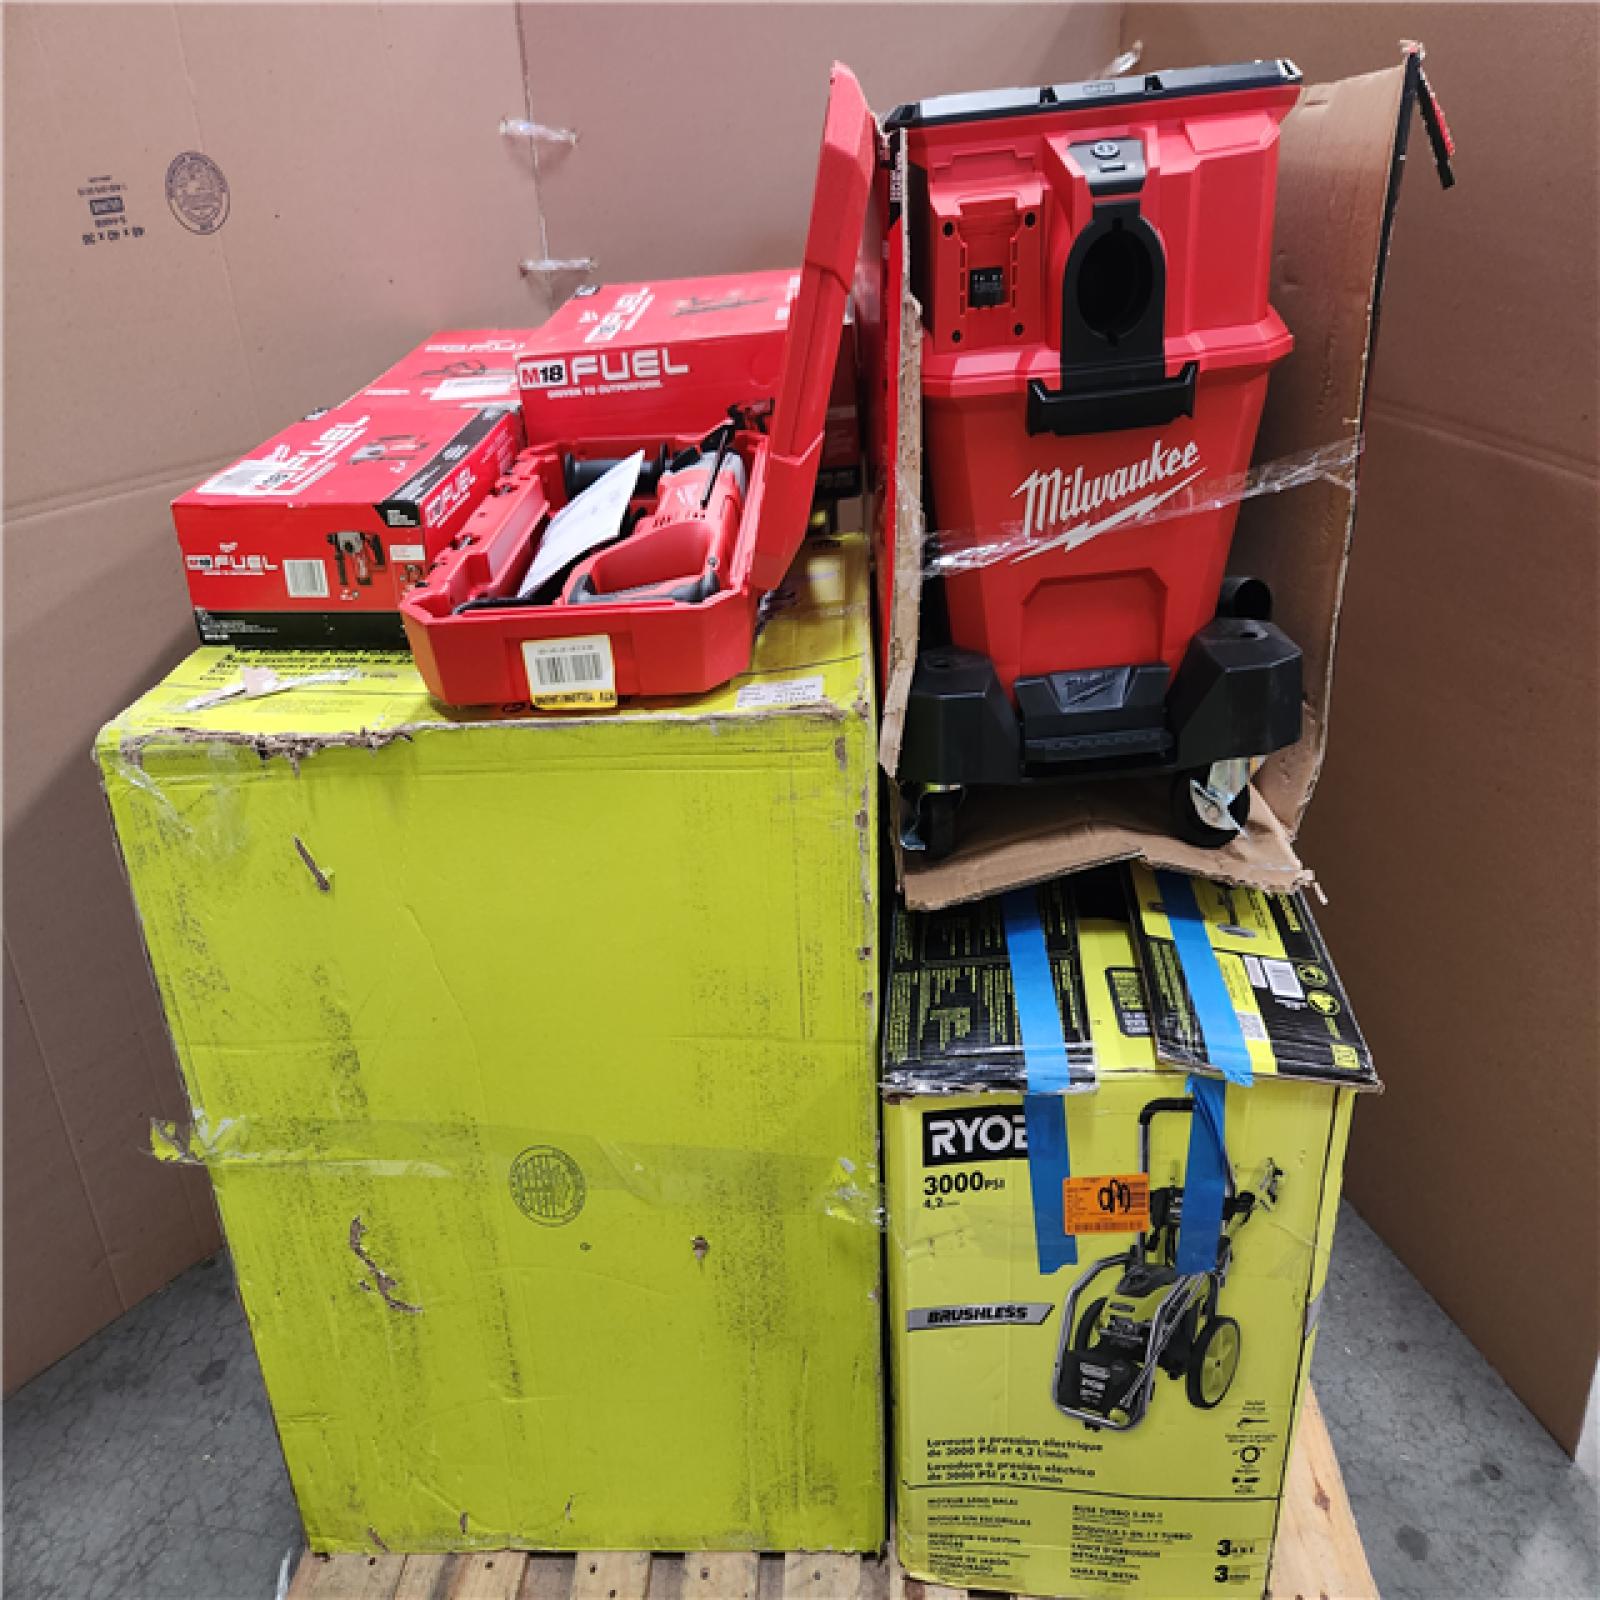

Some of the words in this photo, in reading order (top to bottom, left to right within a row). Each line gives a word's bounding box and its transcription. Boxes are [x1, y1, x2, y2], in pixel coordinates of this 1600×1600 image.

[521, 362, 565, 386] M18
[572, 348, 689, 384] FUEL
[1010, 439, 1201, 539] Milwaukee
[214, 555, 279, 571] FUEL
[928, 1304, 1028, 1324] BRUSHLESS
[1217, 1539, 1231, 1556] 3
[1214, 1565, 1229, 1583] 3
